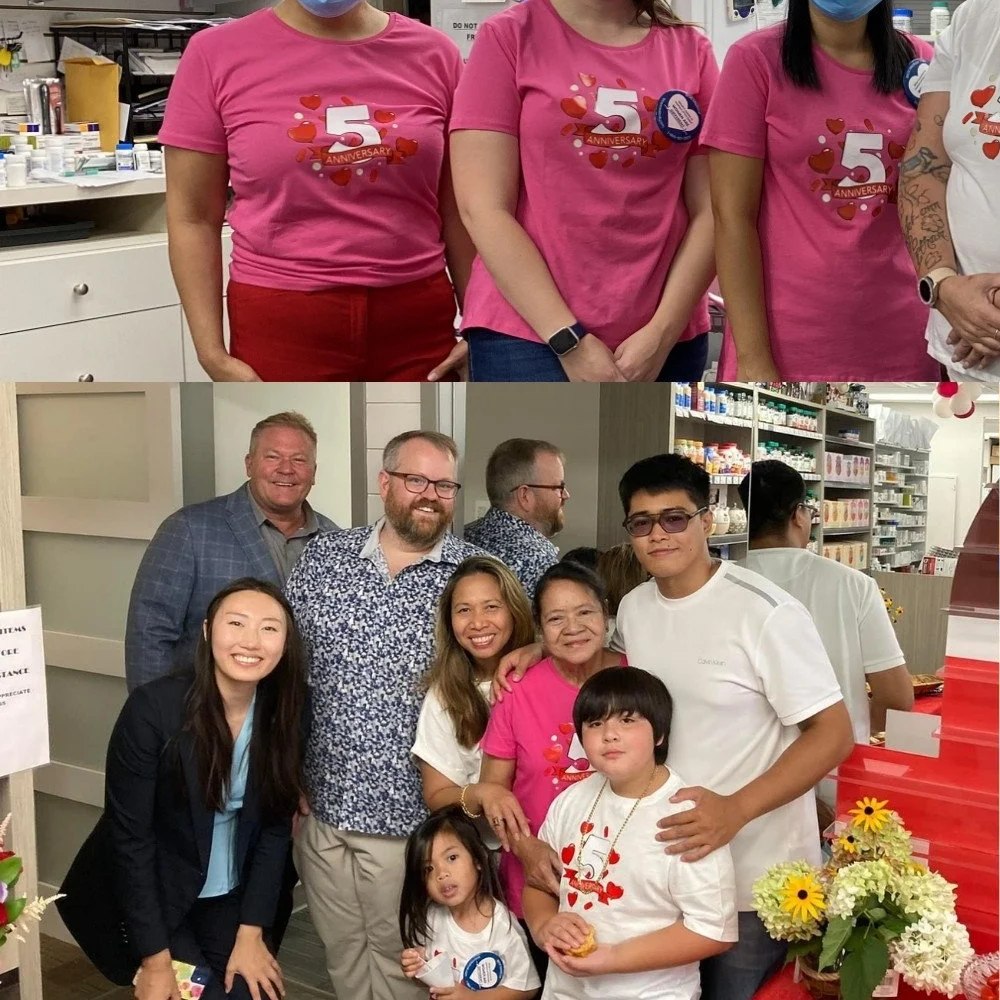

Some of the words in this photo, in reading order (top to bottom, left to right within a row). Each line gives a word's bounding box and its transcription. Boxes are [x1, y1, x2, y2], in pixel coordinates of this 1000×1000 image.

[452, 22, 463, 30] DO
[593, 86, 643, 135] 5
[325, 104, 383, 156] 5
[585, 133, 649, 148] ANNIVERSARY
[325, 147, 392, 166] ANNIVERSARY
[838, 133, 887, 188] 5
[832, 182, 895, 199] ANNIVERSARY
[1, 648, 20, 657] ORE
